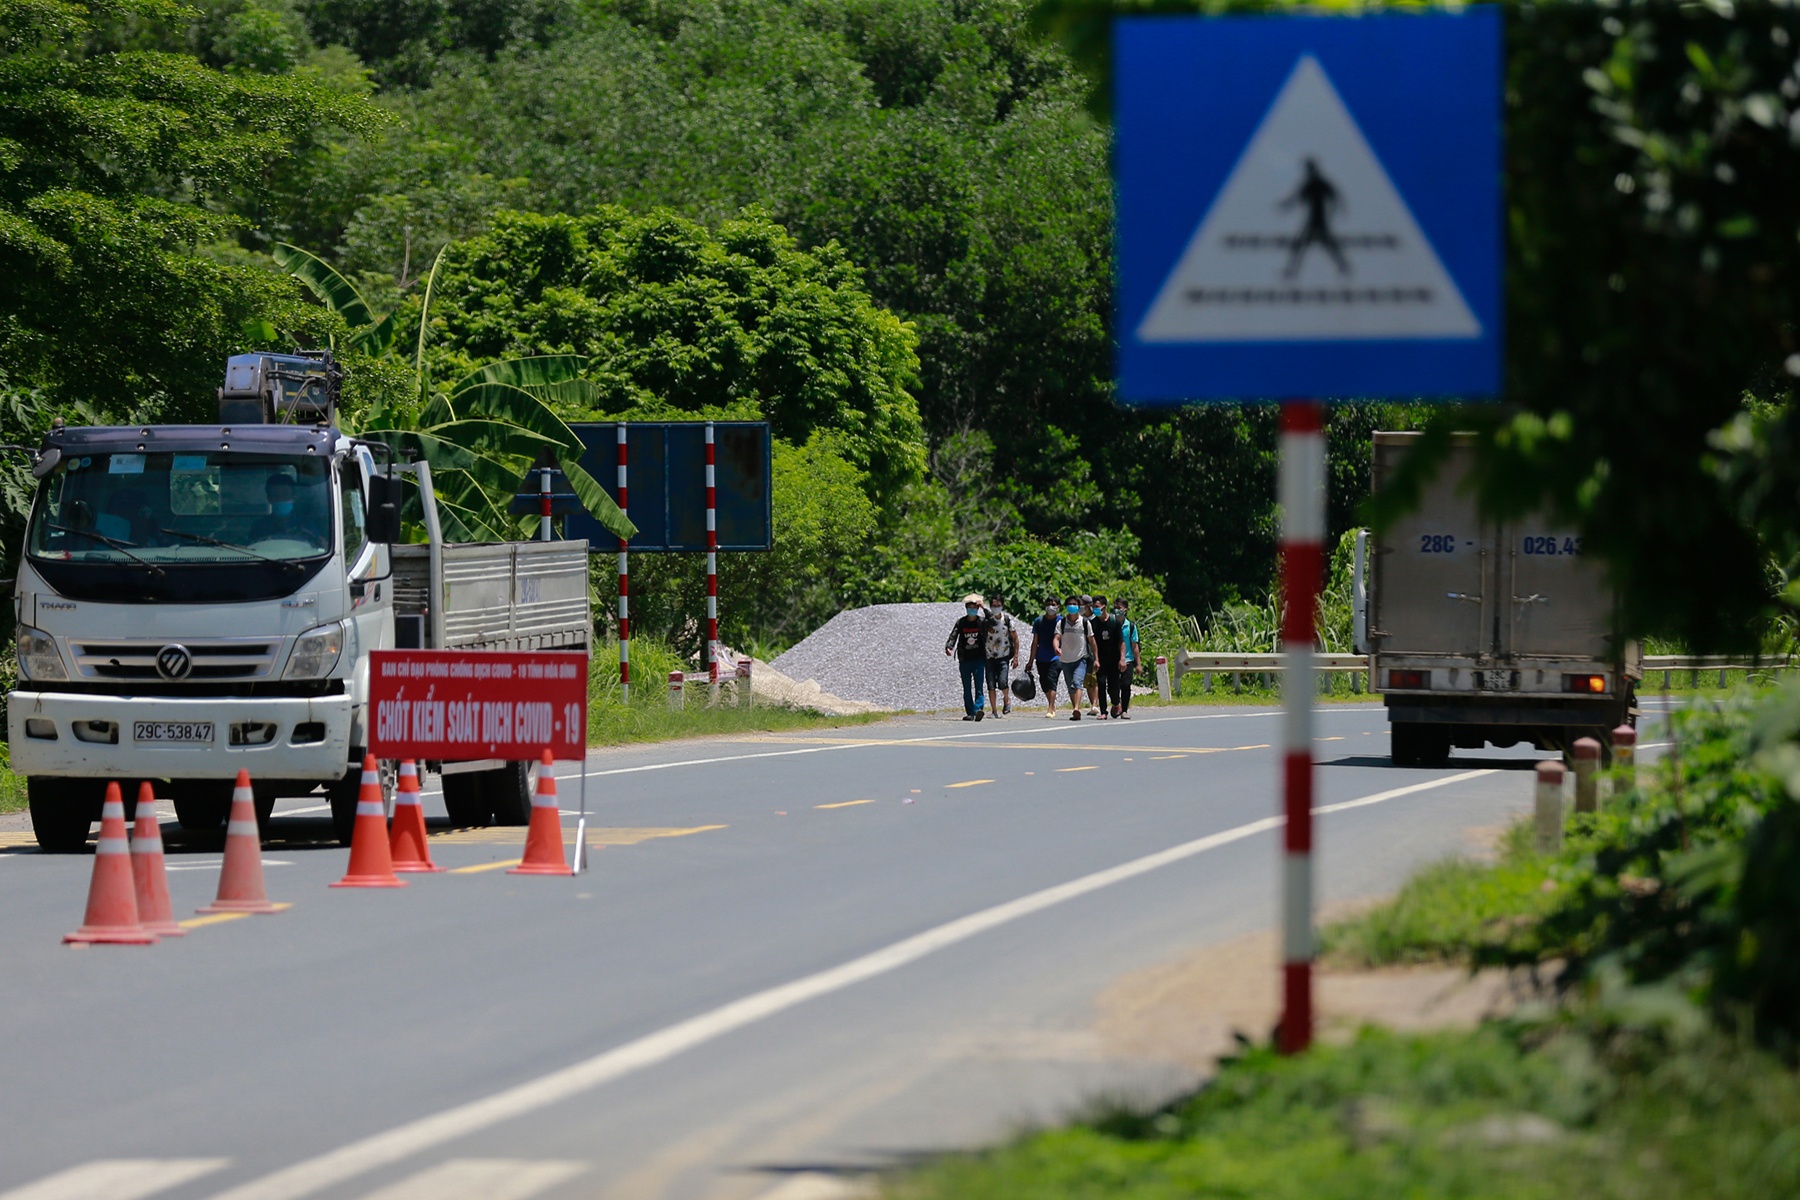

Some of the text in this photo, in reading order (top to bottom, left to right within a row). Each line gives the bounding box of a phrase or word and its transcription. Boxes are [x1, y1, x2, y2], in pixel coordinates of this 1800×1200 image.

[1420, 534, 1455, 553] 28C
[381, 662, 397, 677] BAN
[397, 657, 410, 677] CHỈ
[425, 660, 449, 678] PHÒNG
[449, 658, 473, 678] CHỐNG
[474, 662, 491, 680] DỊCH
[491, 662, 512, 678] COVID
[518, 663, 527, 679] 19
[1489, 670, 1506, 679] 28C
[377, 684, 580, 753] CHỐT KIỂM SOÁT DỊCH COVID - 19
[137, 724, 211, 739] 29C-538.47
